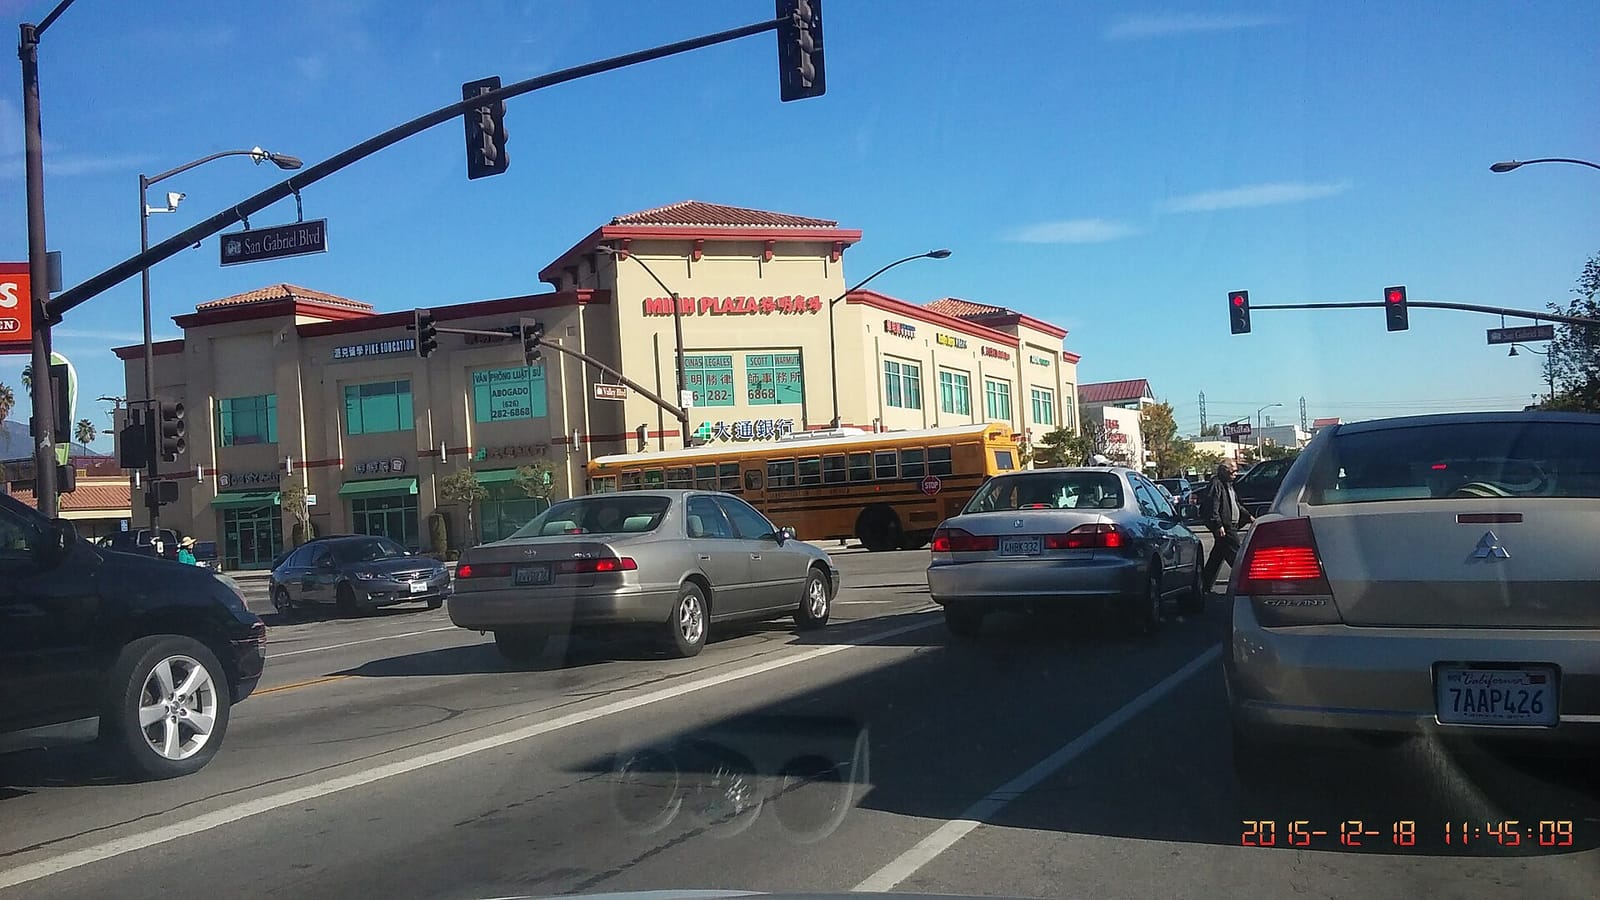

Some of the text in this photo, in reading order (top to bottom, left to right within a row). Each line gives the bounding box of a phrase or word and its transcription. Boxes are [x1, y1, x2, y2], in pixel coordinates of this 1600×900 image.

[244, 226, 320, 254] San Gabriel Blvd
[700, 296, 759, 315] PLAZA
[364, 339, 415, 355] PIKE EDUCATION
[705, 357, 731, 368] LEGALES
[750, 356, 769, 367] SCOTT
[492, 387, 529, 398] ABOGADO
[748, 388, 775, 400] 6868
[502, 400, 520, 408] (626)
[492, 407, 530, 419] 282-6868
[713, 418, 794, 440] 大通銀行
[924, 481, 939, 489] STOP
[1462, 672, 1525, 688] California
[1449, 687, 1544, 714] 7AAP426
